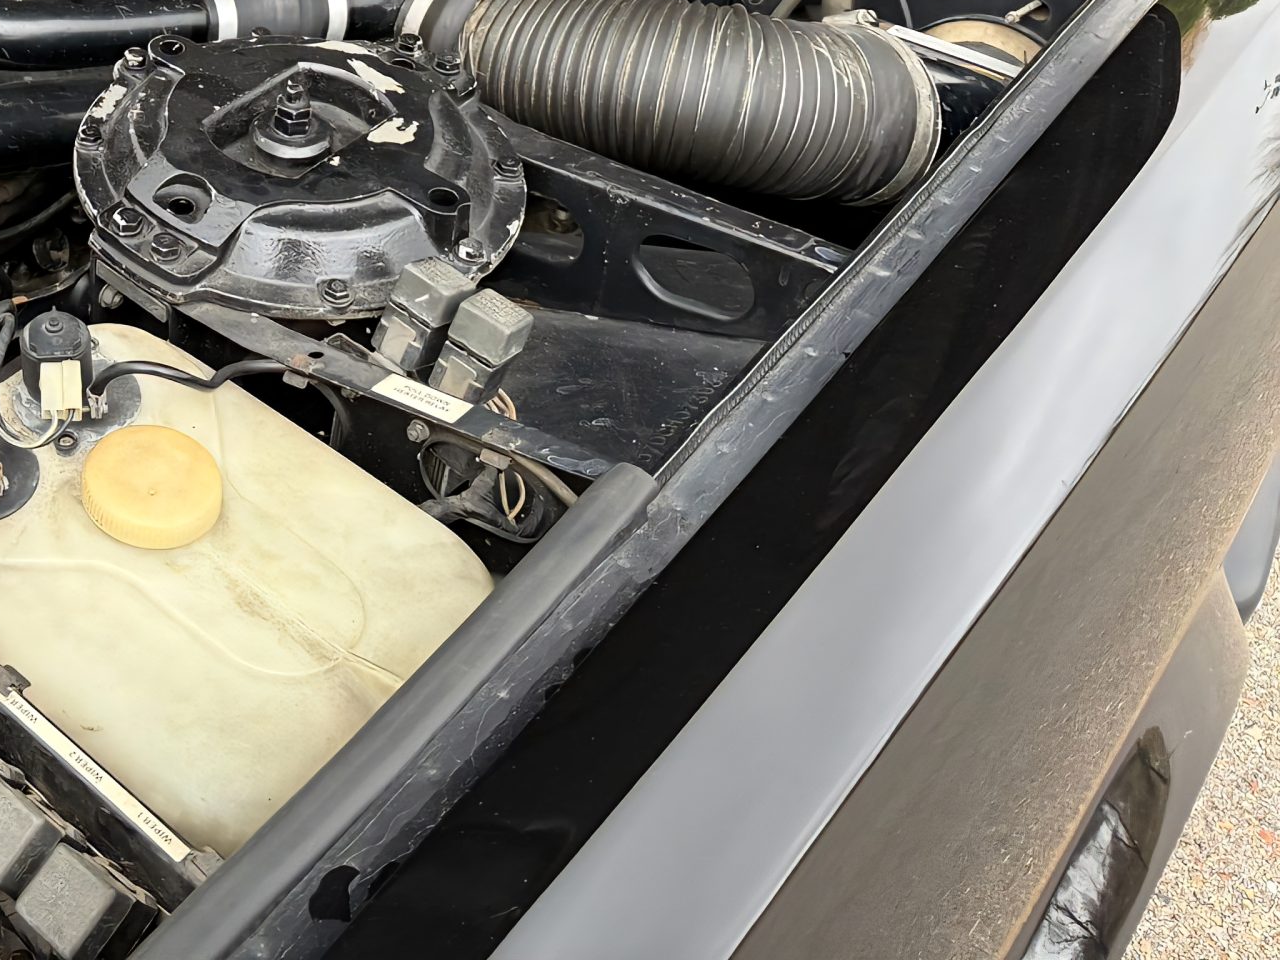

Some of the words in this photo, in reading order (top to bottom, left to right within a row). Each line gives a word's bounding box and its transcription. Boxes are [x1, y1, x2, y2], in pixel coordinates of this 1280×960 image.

[10, 698, 38, 724] WIPER
[75, 756, 103, 782] WIPER
[143, 816, 172, 845] WIPER
